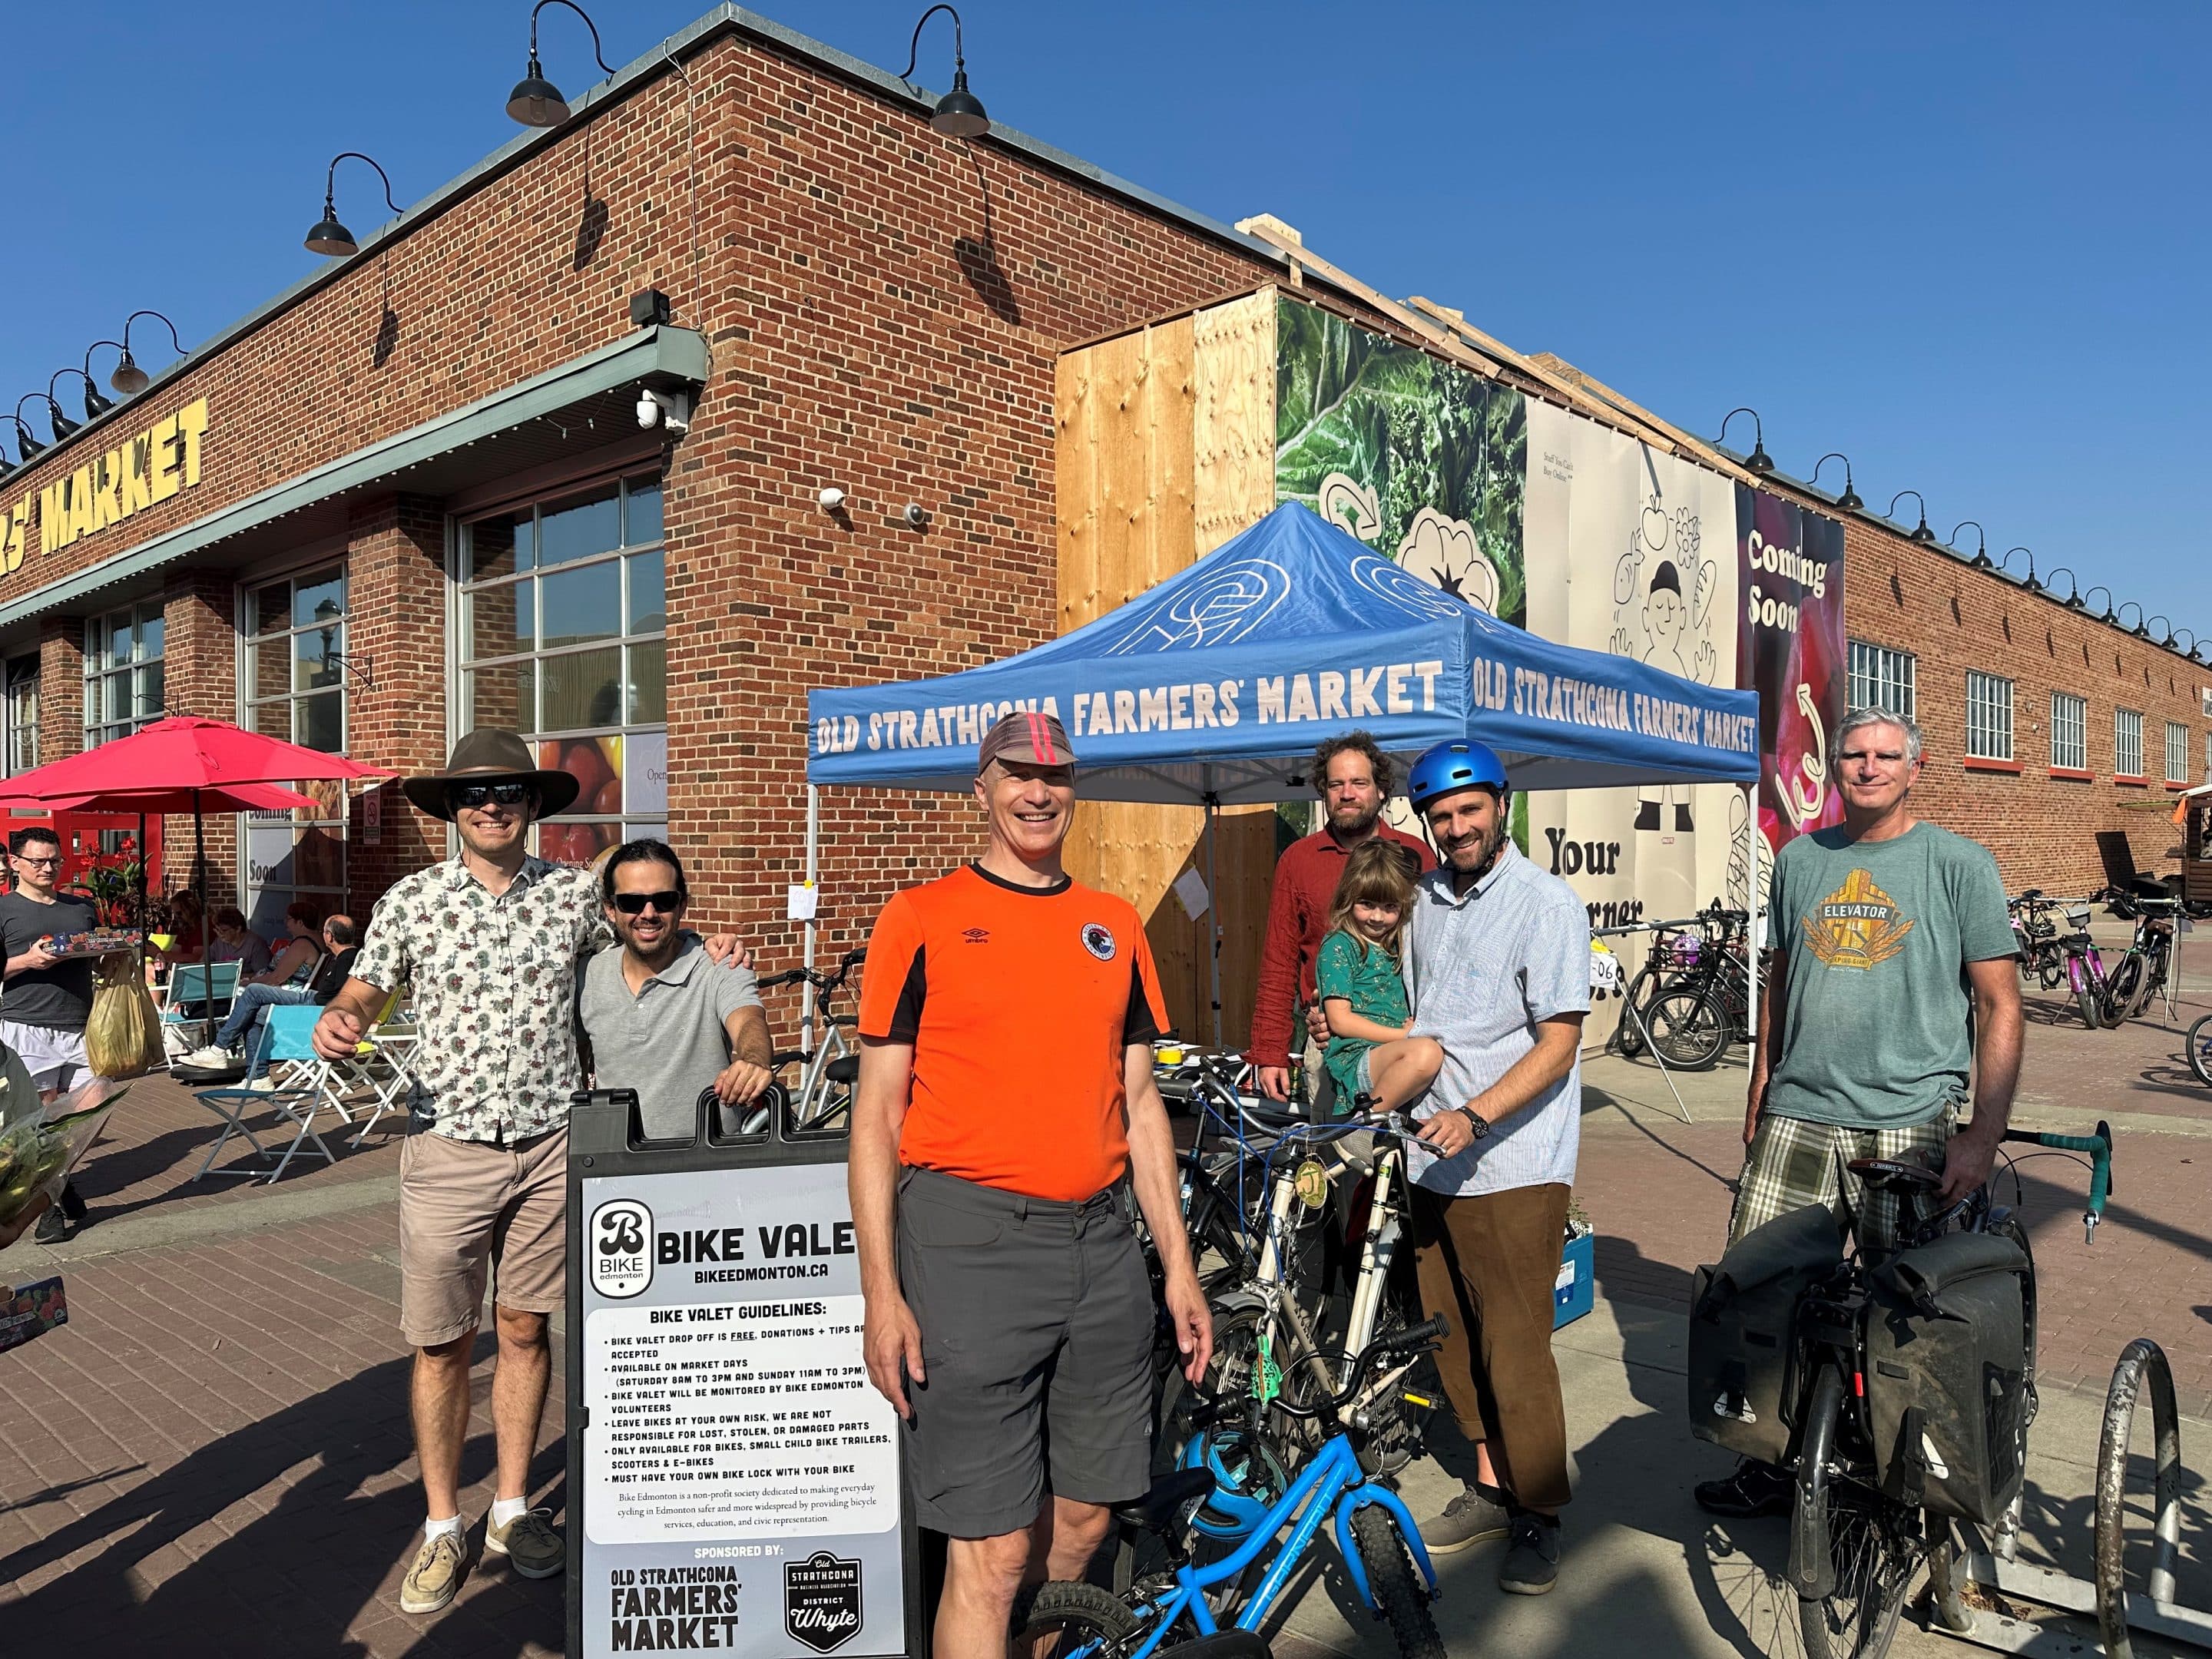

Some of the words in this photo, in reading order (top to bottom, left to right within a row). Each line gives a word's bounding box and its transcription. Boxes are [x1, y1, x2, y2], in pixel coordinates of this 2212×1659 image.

[41, 396, 209, 556] MARKET
[1747, 529, 1827, 599] Coming
[1748, 584, 1798, 634] Soon
[817, 716, 859, 753] OLD
[1074, 680, 1246, 735] FARMERS'
[1257, 661, 1443, 724] MARKET
[1473, 657, 1507, 711] OLD
[1513, 667, 1633, 732] STRATHCONA
[1634, 693, 1701, 746] FARMERS'
[1704, 709, 1756, 753] MARKET
[647, 768, 667, 784] Open
[1544, 826, 1621, 876] Your
[250, 859, 277, 882] Soon
[1585, 900, 1644, 937] rner
[1823, 905, 1887, 919] ELEVATOR
[657, 1227, 744, 1265] BIKE
[758, 1221, 856, 1259] VALE
[600, 1257, 644, 1273] BIKE
[694, 1263, 829, 1284] BIKEEDMONTON.CA
[599, 1272, 644, 1280] edmonton
[650, 1309, 684, 1324] BIKE
[687, 1306, 734, 1322] VALET
[738, 1301, 827, 1320] GUIDELINES:
[611, 1336, 633, 1346] BIKE
[635, 1335, 666, 1345] VALET
[668, 1334, 694, 1343] DROP
[697, 1333, 715, 1343] OFF
[717, 1333, 727, 1341] IS
[730, 1331, 758, 1343] FREE,
[760, 1327, 815, 1339] DONATIONS
[828, 1325, 851, 1335] TIPS
[611, 1349, 659, 1359] ACCEPTED
[611, 1363, 661, 1374] AVAILABLE
[664, 1362, 677, 1371] ON
[680, 1360, 720, 1370] MARKET
[723, 1359, 748, 1369] DAYS
[615, 1376, 668, 1388] (SATURDAY
[671, 1375, 692, 1385] 8AM
[695, 1374, 708, 1383] TO
[711, 1373, 732, 1382] 3PM
[735, 1372, 754, 1382] AND
[757, 1369, 796, 1380] SUNDAY
[799, 1368, 822, 1379] 11AM
[825, 1367, 838, 1377] TO
[842, 1365, 868, 1376] 3PM)
[611, 1391, 633, 1400] BIKE
[636, 1390, 666, 1400] VALET
[669, 1389, 692, 1399] WILL
[694, 1388, 707, 1397] BE
[710, 1386, 766, 1396] MONITORED
[769, 1384, 782, 1394] BY
[785, 1383, 807, 1392] BIKE
[810, 1379, 863, 1392] EDMONTON
[611, 1403, 672, 1414] VOLUNTEERS
[611, 1419, 641, 1428] LEAVE
[644, 1417, 672, 1427] BIKES
[675, 1416, 688, 1426] AT
[690, 1416, 716, 1426] YOUR
[719, 1414, 740, 1424] OWN
[743, 1412, 770, 1422] RISK,
[772, 1412, 787, 1421] WE
[790, 1411, 810, 1420] ARE
[812, 1409, 832, 1419] NOT
[611, 1431, 675, 1442] RESPONSIBLE
[677, 1430, 697, 1439] FOR
[700, 1429, 727, 1439] LOST,
[730, 1427, 770, 1437] STOLEN,
[773, 1426, 786, 1435] OR
[789, 1423, 835, 1435] DAMAGED
[838, 1421, 870, 1432] PARTS
[611, 1446, 636, 1455] ONLY
[639, 1444, 690, 1455] AVAILABLE
[693, 1443, 712, 1452] FOR
[715, 1442, 747, 1452] BIKES,
[749, 1440, 781, 1450] SMALL
[784, 1439, 813, 1449] CHILD
[816, 1437, 839, 1447] BIKE
[841, 1434, 891, 1445] TRAILERS,
[611, 1459, 660, 1469] SCOOTERS
[663, 1459, 670, 1468] &
[673, 1457, 714, 1468] E-BIKES
[611, 1474, 638, 1483] MUST
[641, 1473, 666, 1482] HAVE
[669, 1472, 694, 1482] YOUR
[697, 1471, 719, 1481] OWN
[722, 1470, 744, 1479] BIKE
[747, 1469, 773, 1479] LOCK
[775, 1467, 800, 1477] WITH
[803, 1465, 830, 1475] YOUR
[833, 1464, 855, 1474] BIKE
[619, 1493, 635, 1502] Bike
[637, 1492, 677, 1501] Edmonton
[693, 1489, 732, 1502] non-profit
[734, 1489, 760, 1499] society
[762, 1486, 798, 1496] dedicated
[810, 1485, 839, 1495] making
[841, 1482, 875, 1494] everyday
[618, 1507, 644, 1518] cycling
[655, 1506, 696, 1516] Edmonton
[697, 1504, 716, 1513] safer
[755, 1501, 797, 1512] widespread
[799, 1499, 809, 1511] by
[811, 1498, 849, 1511] providing
[850, 1496, 876, 1508] bicycle
[697, 1518, 736, 1528] education,
[738, 1517, 752, 1525] and
[773, 1515, 830, 1527] representation.
[694, 1546, 762, 1558] SPONSORED
[765, 1544, 784, 1556] BY:
[1266, 1492, 1333, 1601] GARNEAU
[814, 1559, 830, 1568] Old
[611, 1569, 635, 1586] OLD
[640, 1565, 737, 1585] STRATHCONA
[792, 1569, 854, 1581] STRATHCONA
[611, 1583, 742, 1618] FARMERS'
[803, 1597, 843, 1605] DISTRICT
[790, 1607, 857, 1632] Whyte
[611, 1615, 739, 1652] MARKET
